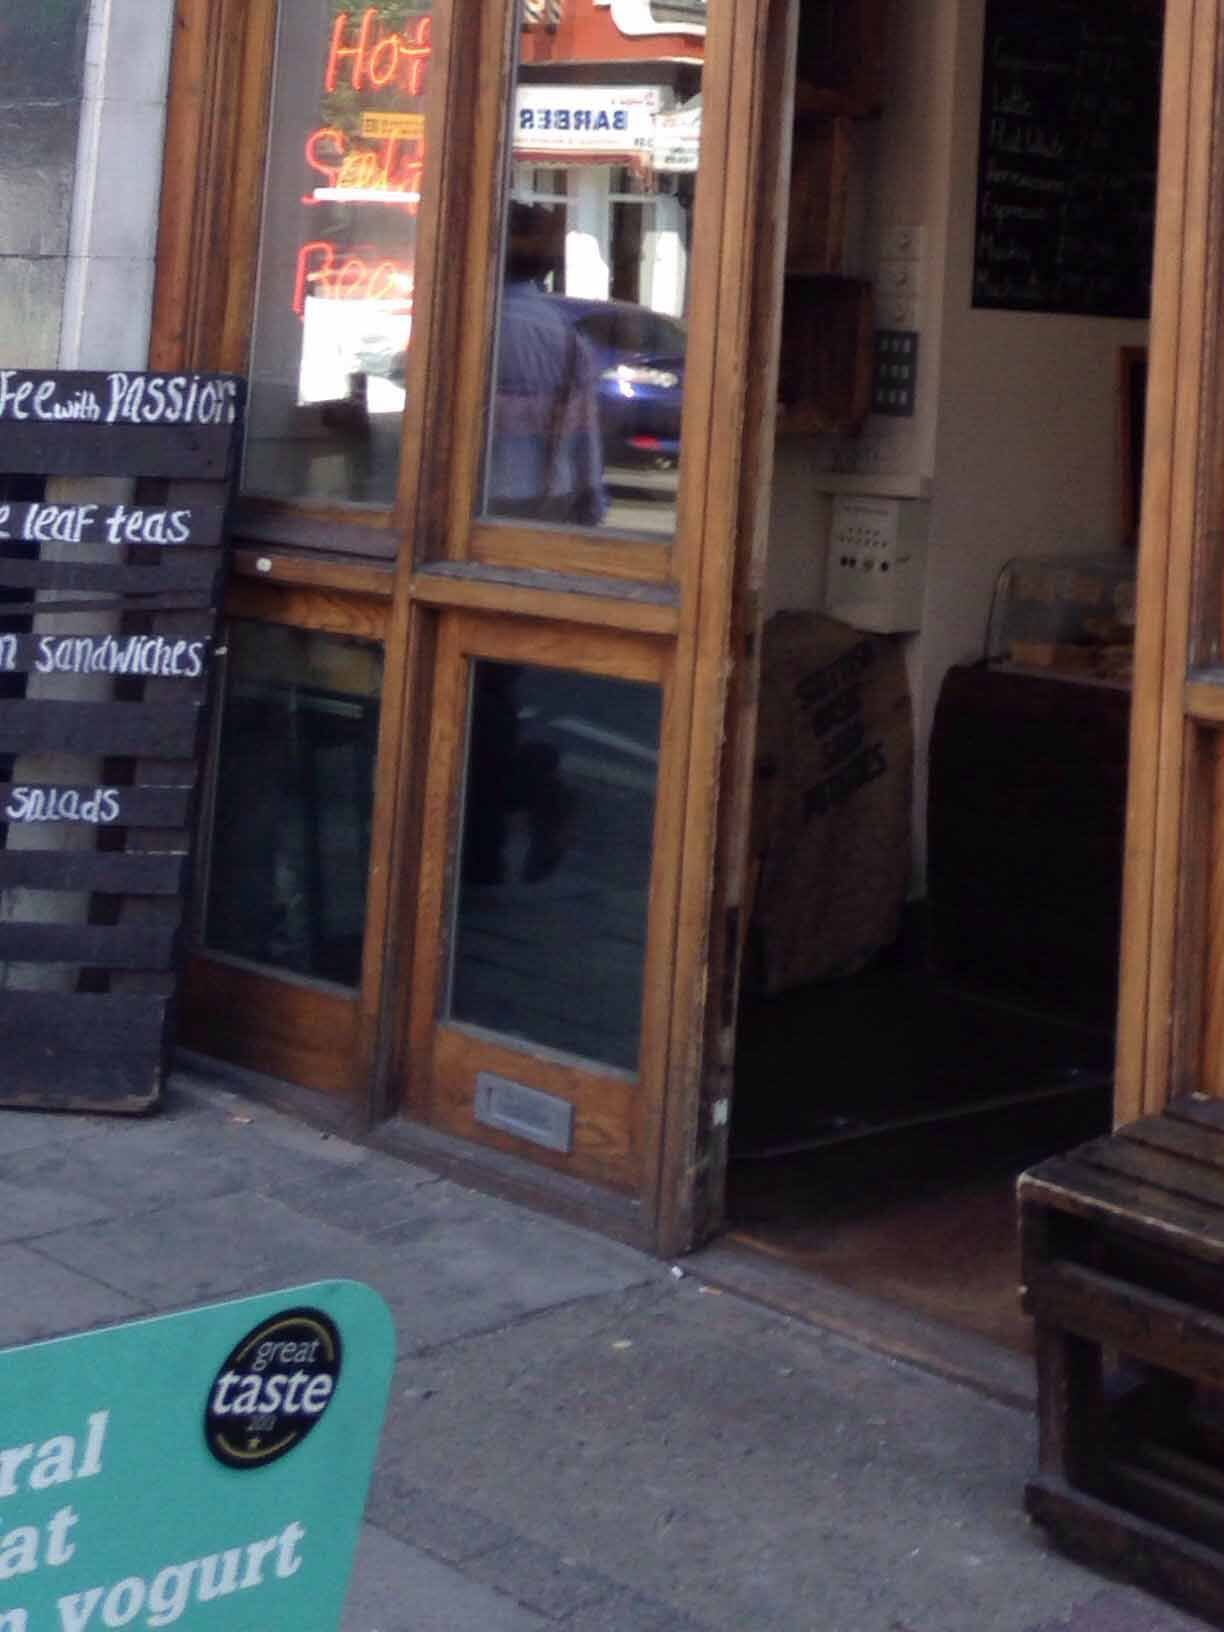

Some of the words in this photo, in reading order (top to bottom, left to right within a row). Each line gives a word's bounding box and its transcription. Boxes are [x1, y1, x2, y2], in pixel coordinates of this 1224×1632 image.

[325, 7, 432, 96] Hot
[53, 389, 101, 421] with
[106, 505, 191, 544] teas
[253, 1337, 321, 1371] great
[211, 1369, 333, 1417] taste
[57, 1520, 306, 1632] yogurt
